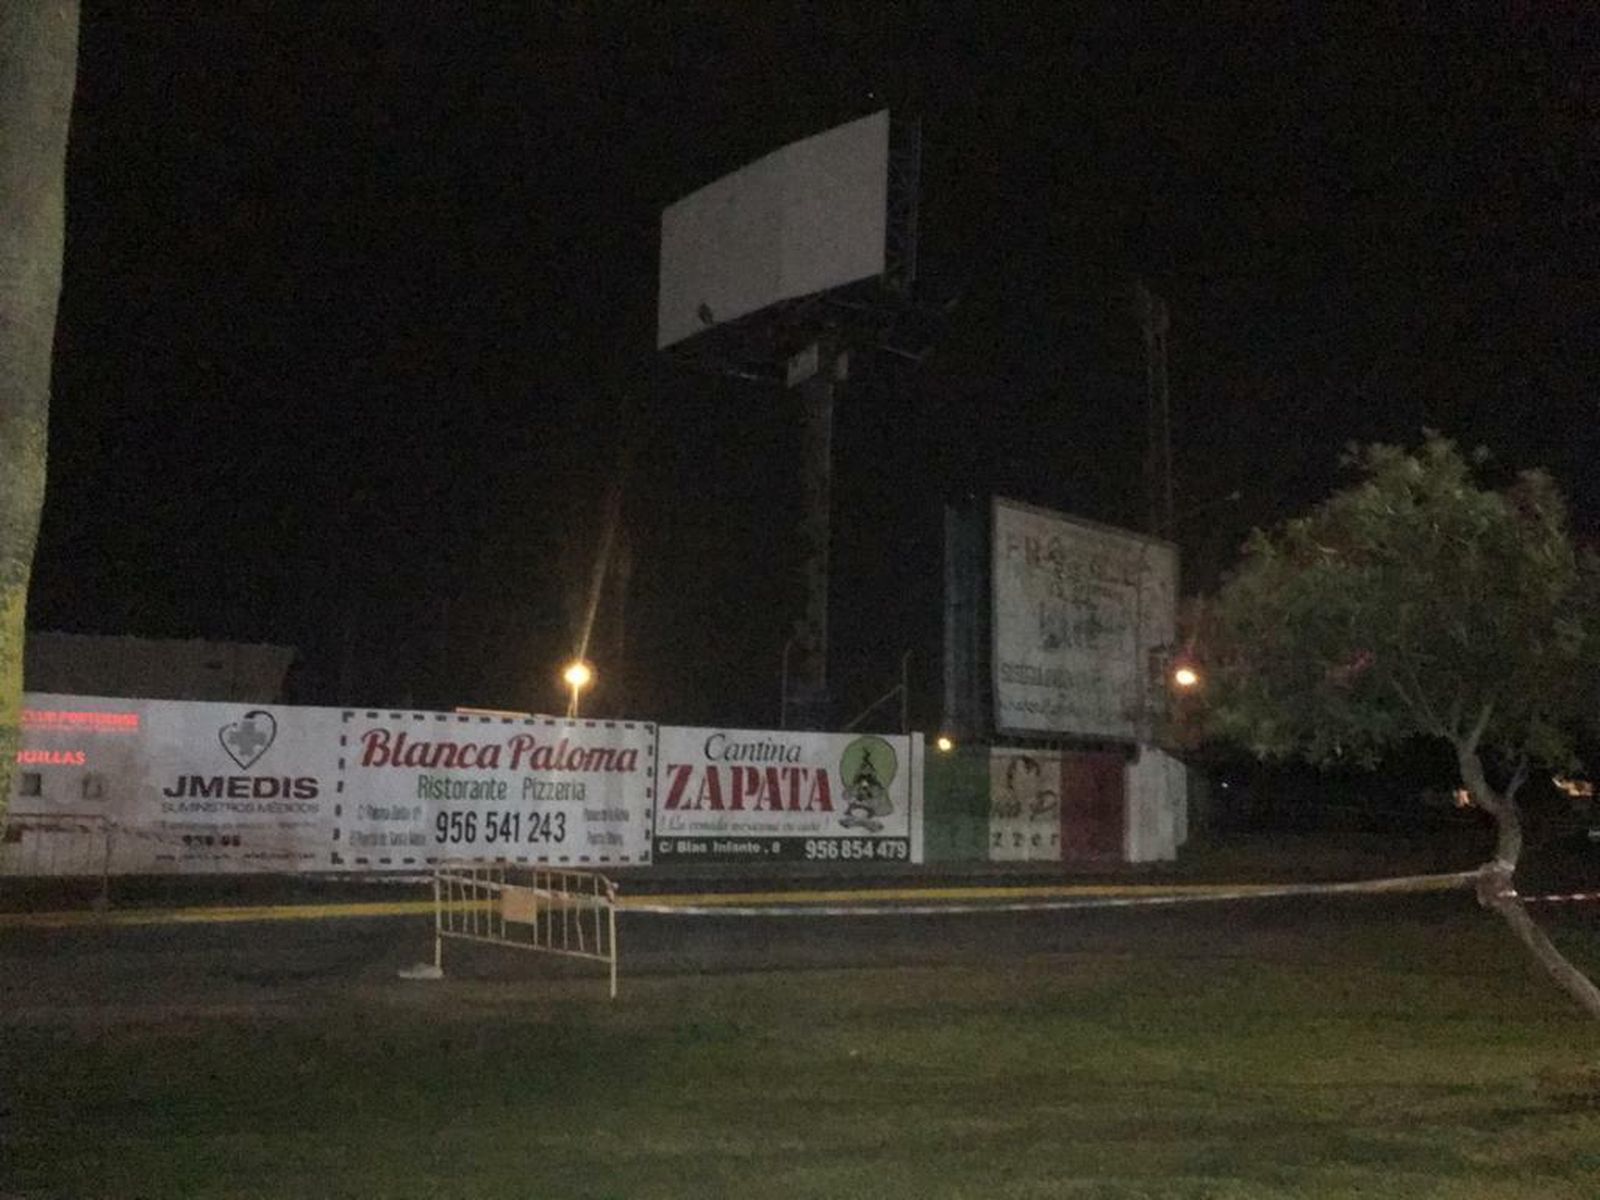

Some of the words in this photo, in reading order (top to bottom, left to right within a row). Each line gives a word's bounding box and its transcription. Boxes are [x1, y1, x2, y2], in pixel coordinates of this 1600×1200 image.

[361, 727, 502, 769] Blanca
[508, 733, 640, 773] Paloma
[703, 732, 803, 763] Cantina
[163, 775, 319, 799] JMEDIS
[417, 774, 508, 801] Ristorante
[522, 776, 587, 801] Pizzeria
[663, 763, 836, 813] ZAPATA
[435, 810, 478, 844] 956
[485, 810, 520, 844] 541
[527, 811, 567, 844] 243
[677, 841, 708, 854] Blas
[804, 840, 839, 859] 956
[841, 840, 874, 859] 854
[876, 840, 908, 859] 479
